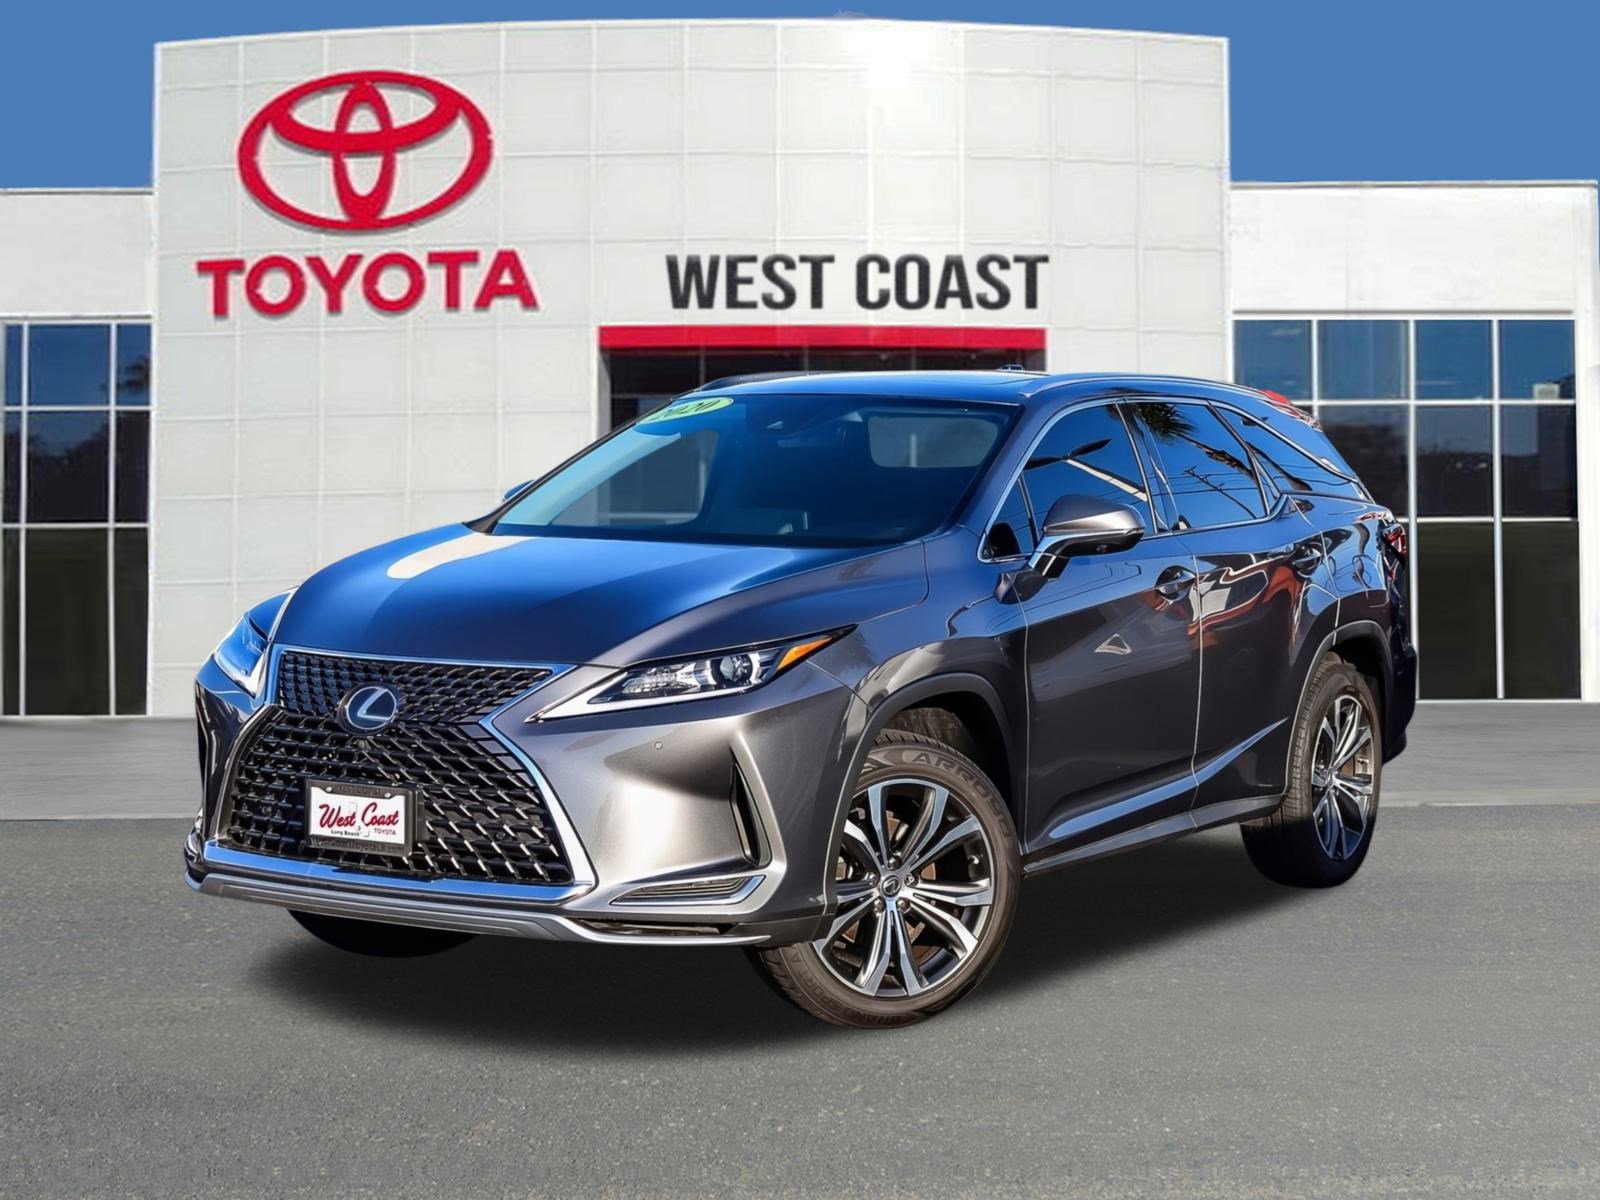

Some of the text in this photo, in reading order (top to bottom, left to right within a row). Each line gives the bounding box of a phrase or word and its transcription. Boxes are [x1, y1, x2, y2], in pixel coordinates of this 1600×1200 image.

[197, 250, 539, 317] TOYOTA
[666, 254, 1049, 310] WEST COAST
[318, 802, 399, 828] West Coast
